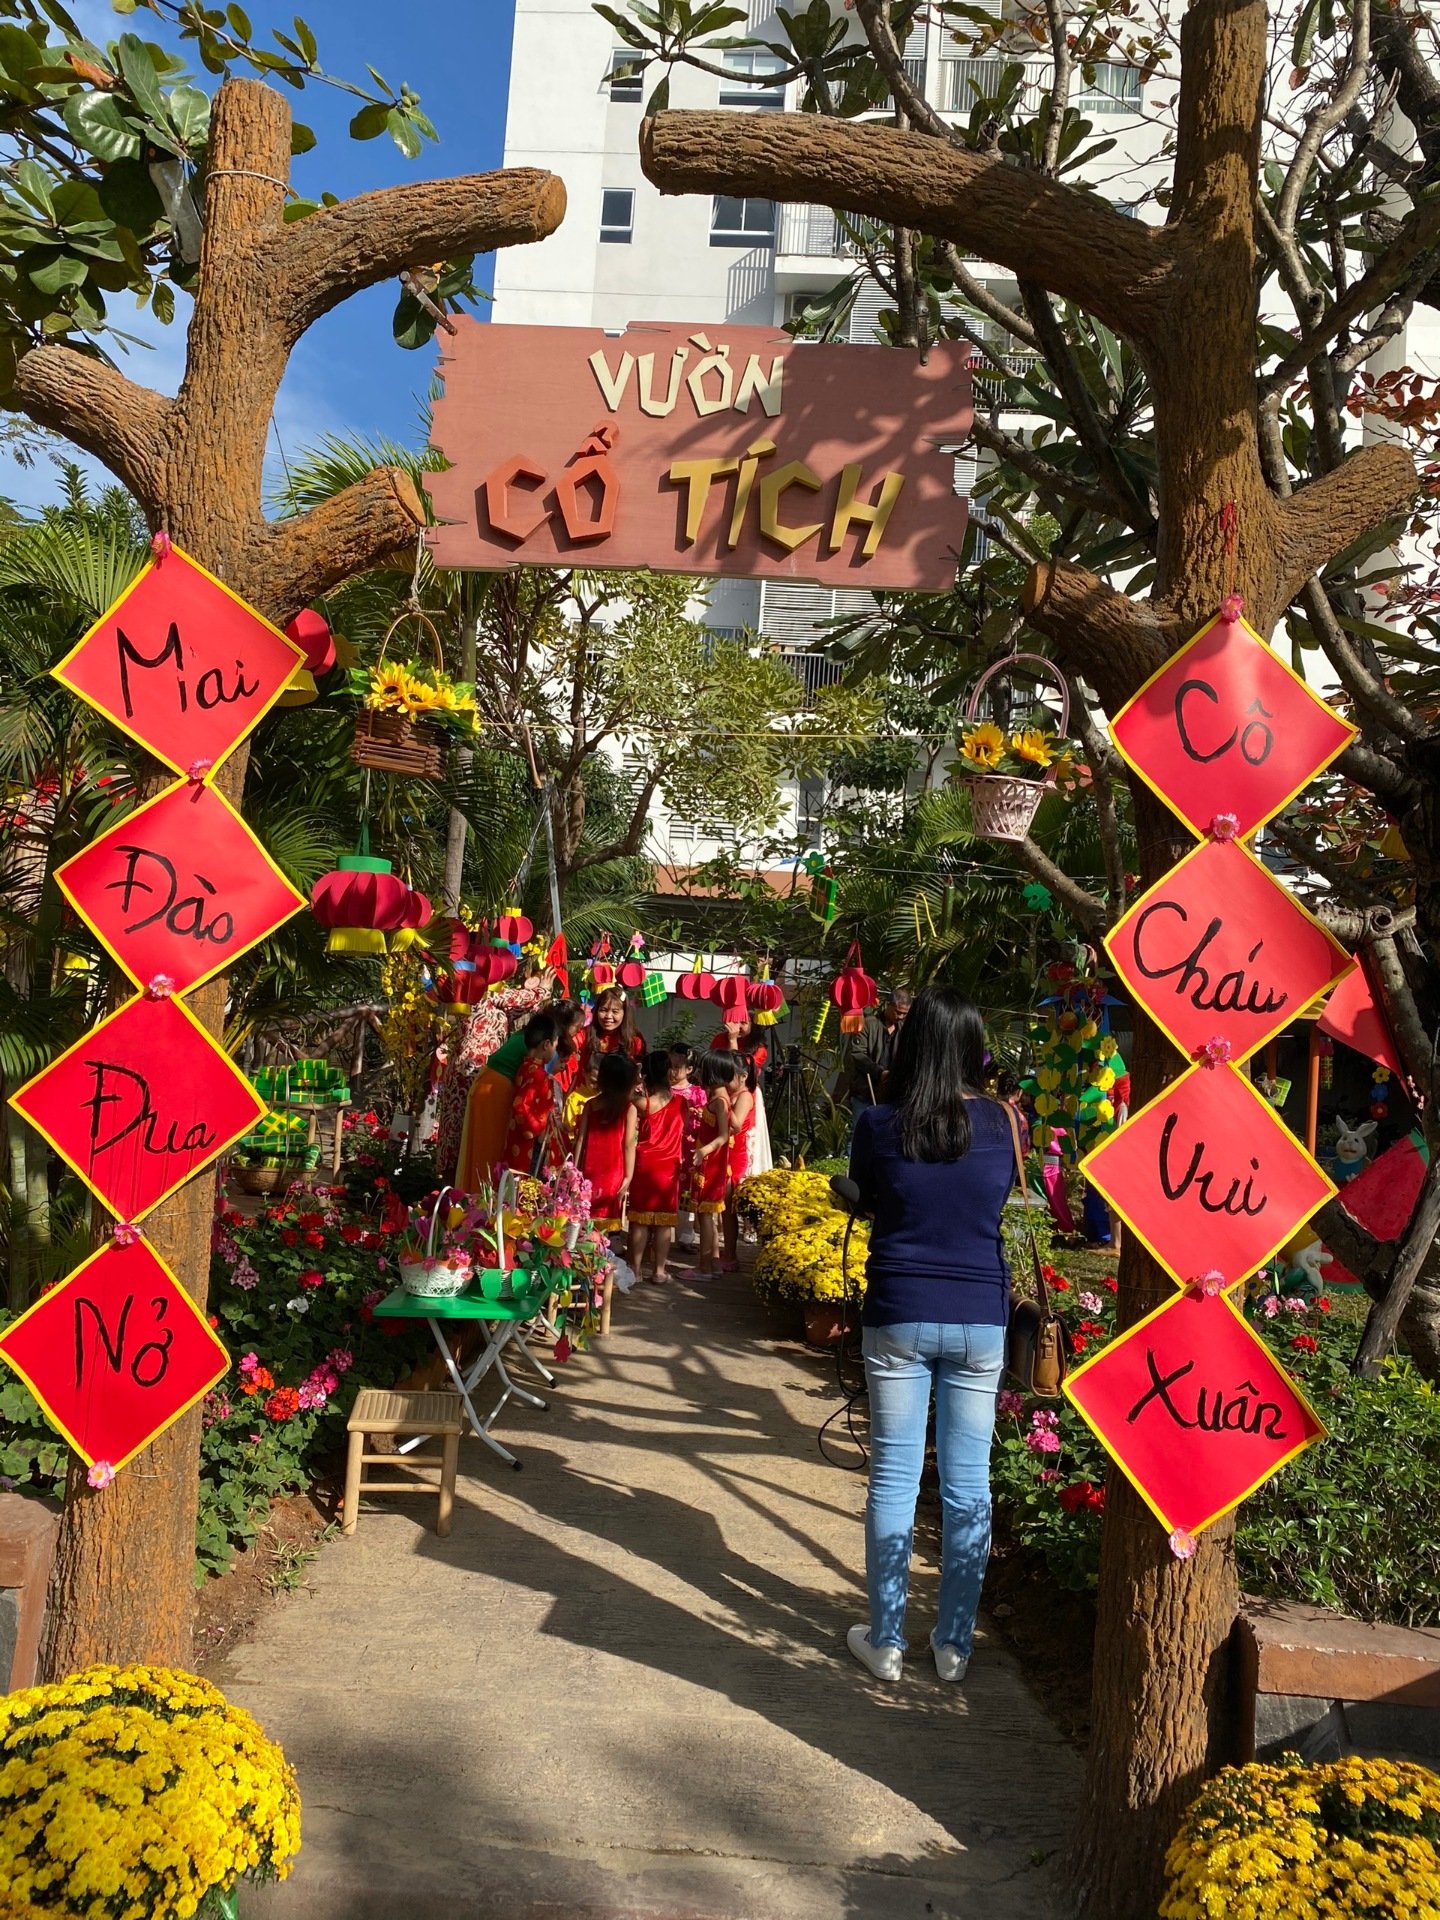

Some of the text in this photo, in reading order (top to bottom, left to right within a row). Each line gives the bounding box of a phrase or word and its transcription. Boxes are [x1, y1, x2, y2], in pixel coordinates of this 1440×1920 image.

[587, 332, 784, 418] VƯỜN
[485, 419, 905, 558] CỔ TÍCH
[116, 622, 260, 718] Mai
[1175, 679, 1274, 767] Cô
[105, 844, 235, 945] Đào
[1133, 901, 1288, 1014] Cháu
[80, 1060, 216, 1156] Đua
[1159, 1112, 1267, 1216] Vui
[73, 1294, 174, 1389] Nở
[1125, 1347, 1288, 1440] Xuân
